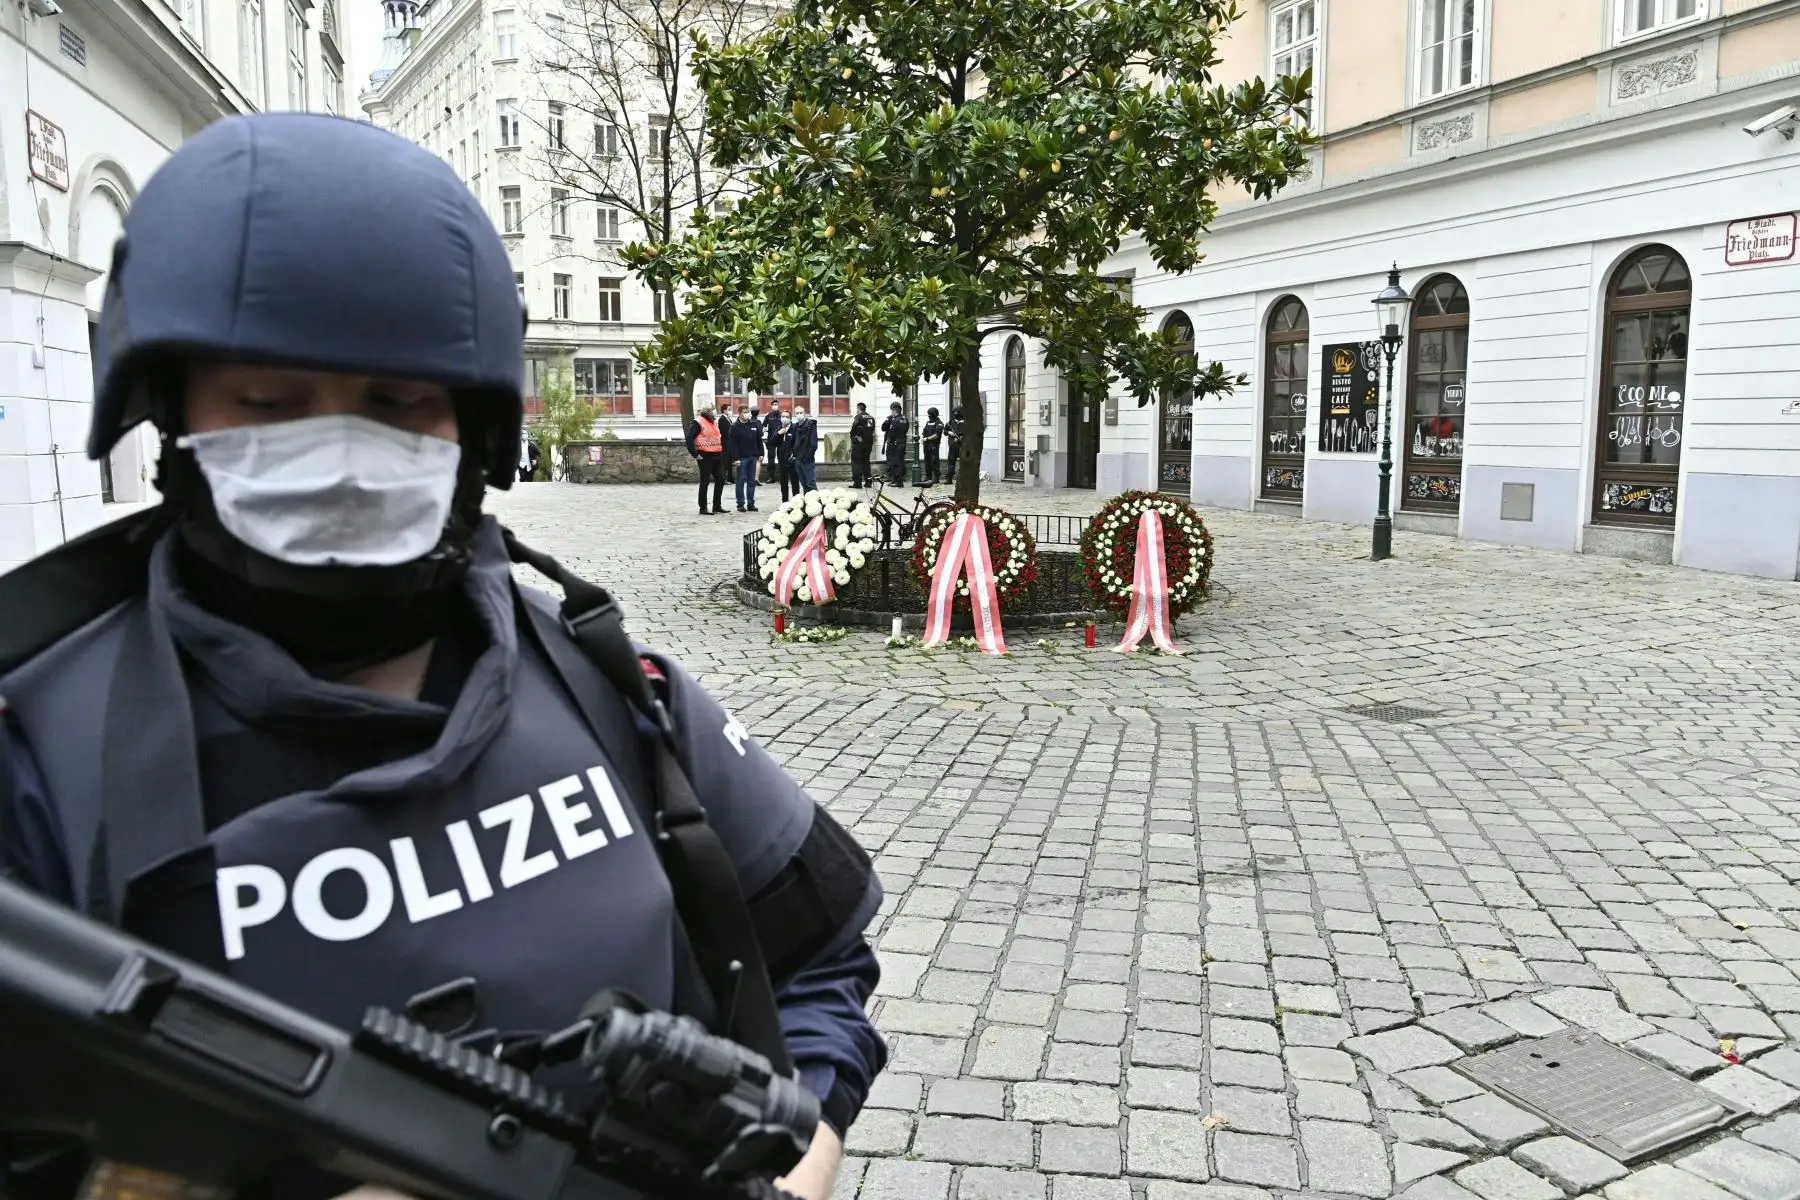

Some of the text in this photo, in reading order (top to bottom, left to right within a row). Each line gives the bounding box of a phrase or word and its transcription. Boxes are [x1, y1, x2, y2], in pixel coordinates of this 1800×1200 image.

[1729, 234, 1792, 253] Friedmann-
[1331, 392, 1350, 404] CAFÉ
[215, 765, 634, 960] POLIZEI
